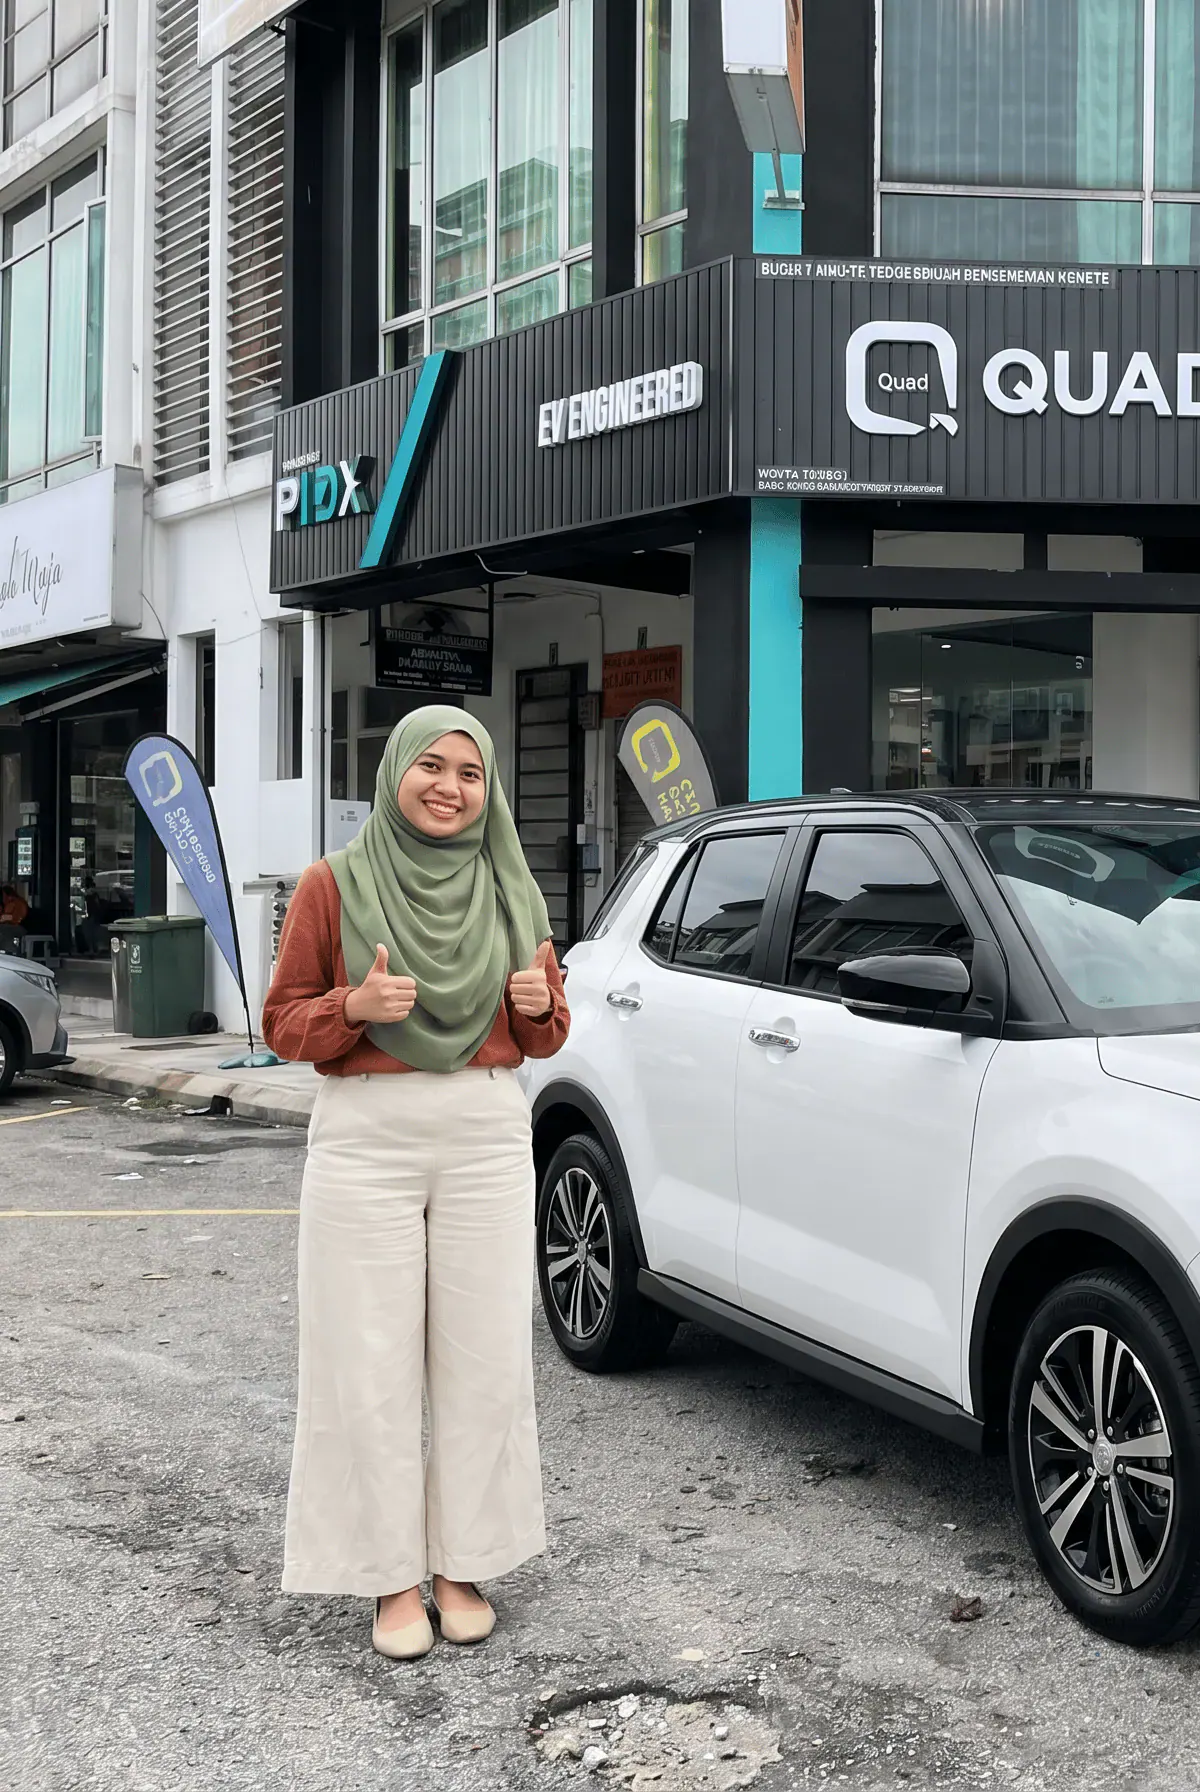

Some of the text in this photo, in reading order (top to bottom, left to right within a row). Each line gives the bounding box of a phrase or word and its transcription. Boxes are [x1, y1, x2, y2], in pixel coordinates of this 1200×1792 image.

[538, 361, 703, 448] EV ENGINEERED
[878, 372, 928, 392] Quad
